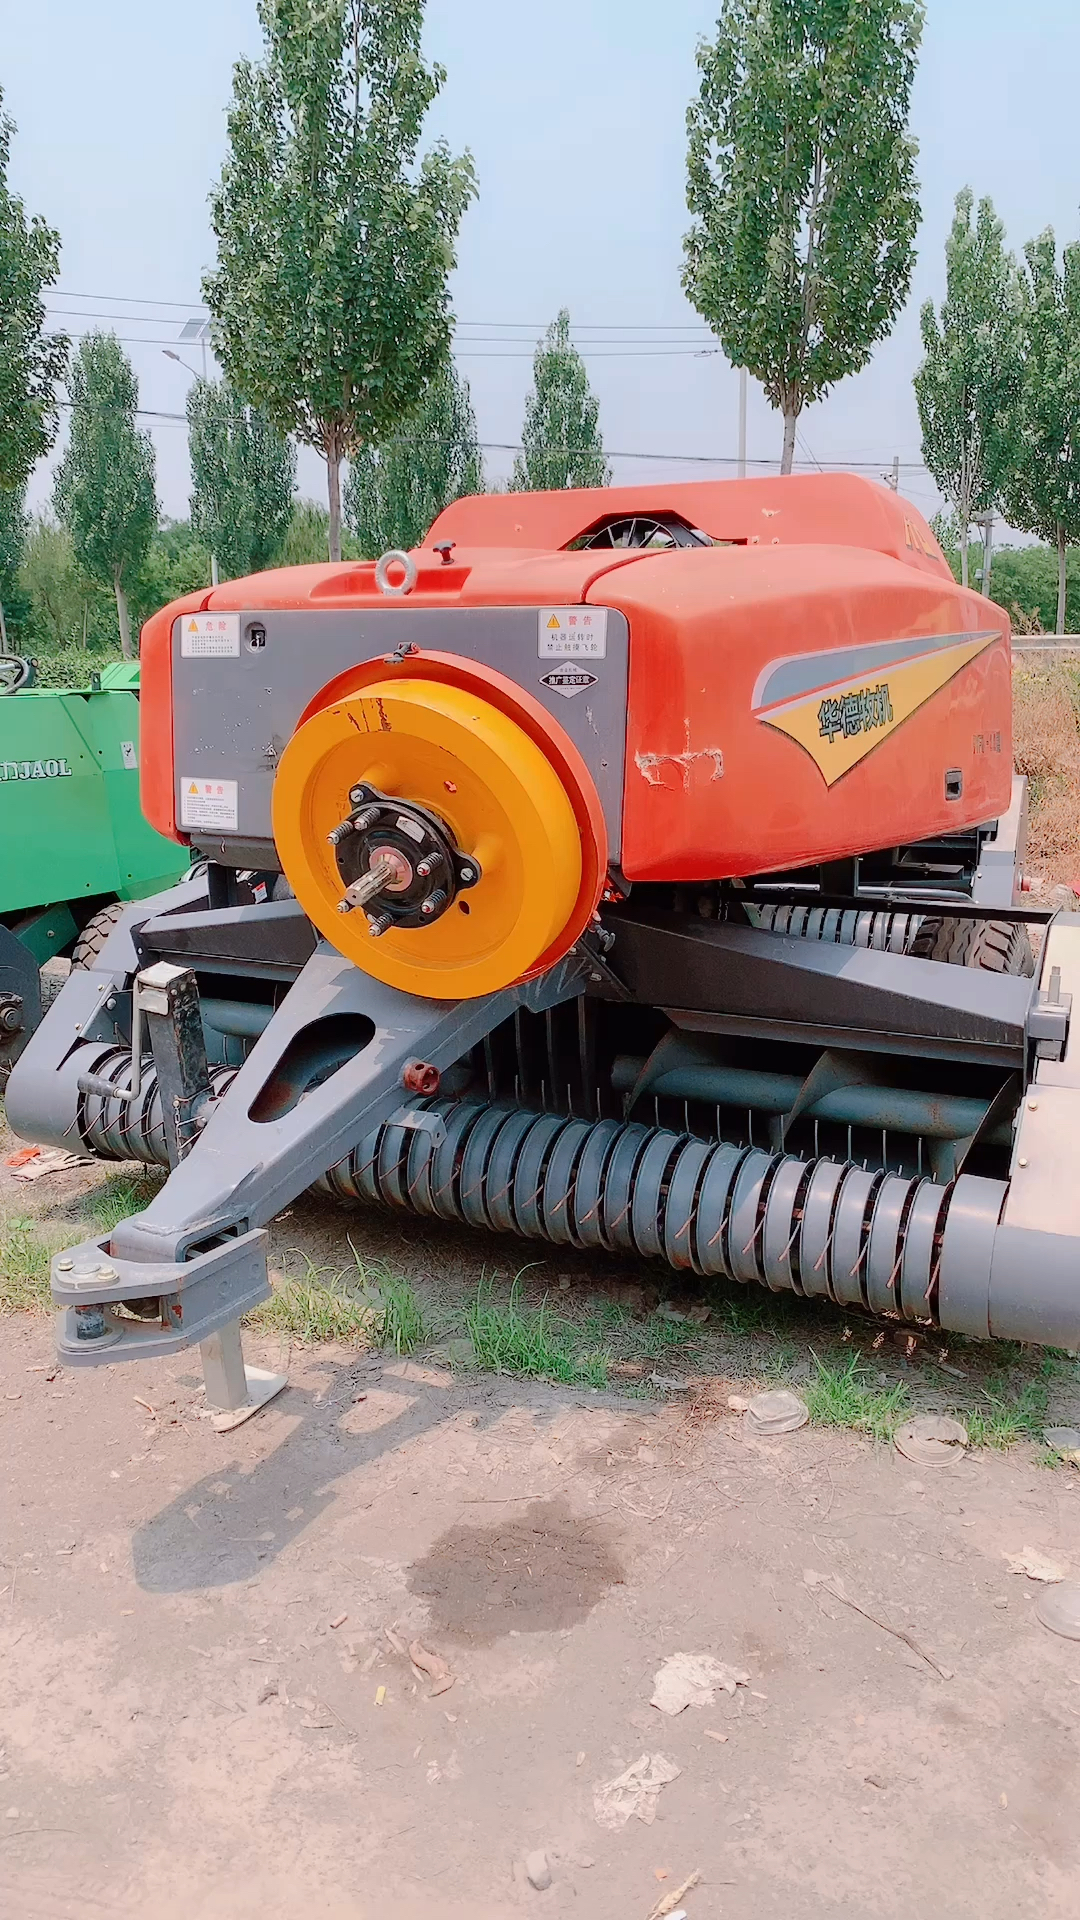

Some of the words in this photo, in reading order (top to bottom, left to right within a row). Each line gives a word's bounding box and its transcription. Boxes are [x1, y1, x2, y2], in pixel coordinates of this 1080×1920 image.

[205, 620, 227, 632] 危险
[568, 615, 593, 626] 警告
[551, 632, 594, 642] 机器运转时
[547, 643, 598, 652] 禁止触摸飞轮
[818, 683, 894, 744] 华德牧机
[204, 784, 225, 795] 警告
